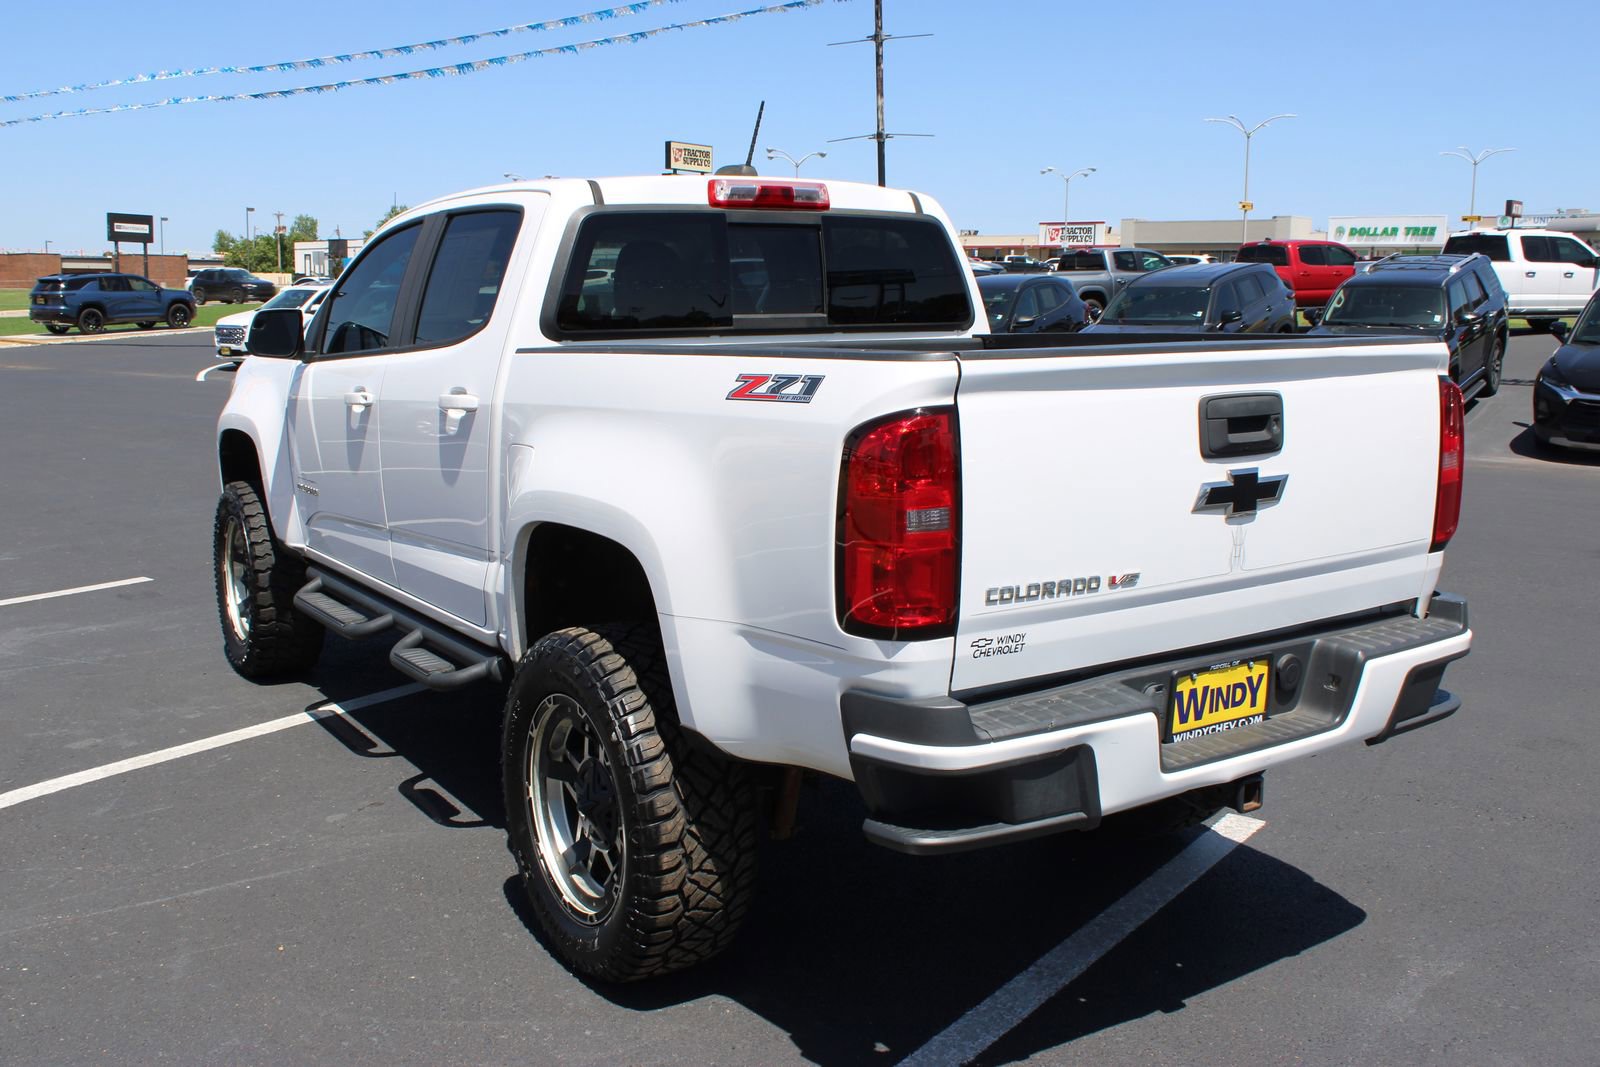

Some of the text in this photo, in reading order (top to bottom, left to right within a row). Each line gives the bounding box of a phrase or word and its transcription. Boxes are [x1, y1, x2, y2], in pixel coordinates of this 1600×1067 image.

[683, 147, 711, 158] TRACTOR
[682, 156, 704, 167] SUPPLY
[1348, 226, 1437, 237] DOLLAR TREE
[725, 373, 826, 401] Z71
[985, 575, 1101, 606] COLORADO
[996, 633, 1027, 645] WINDY
[972, 643, 1026, 659] CHEVROLET
[1175, 673, 1265, 725] WINDY
